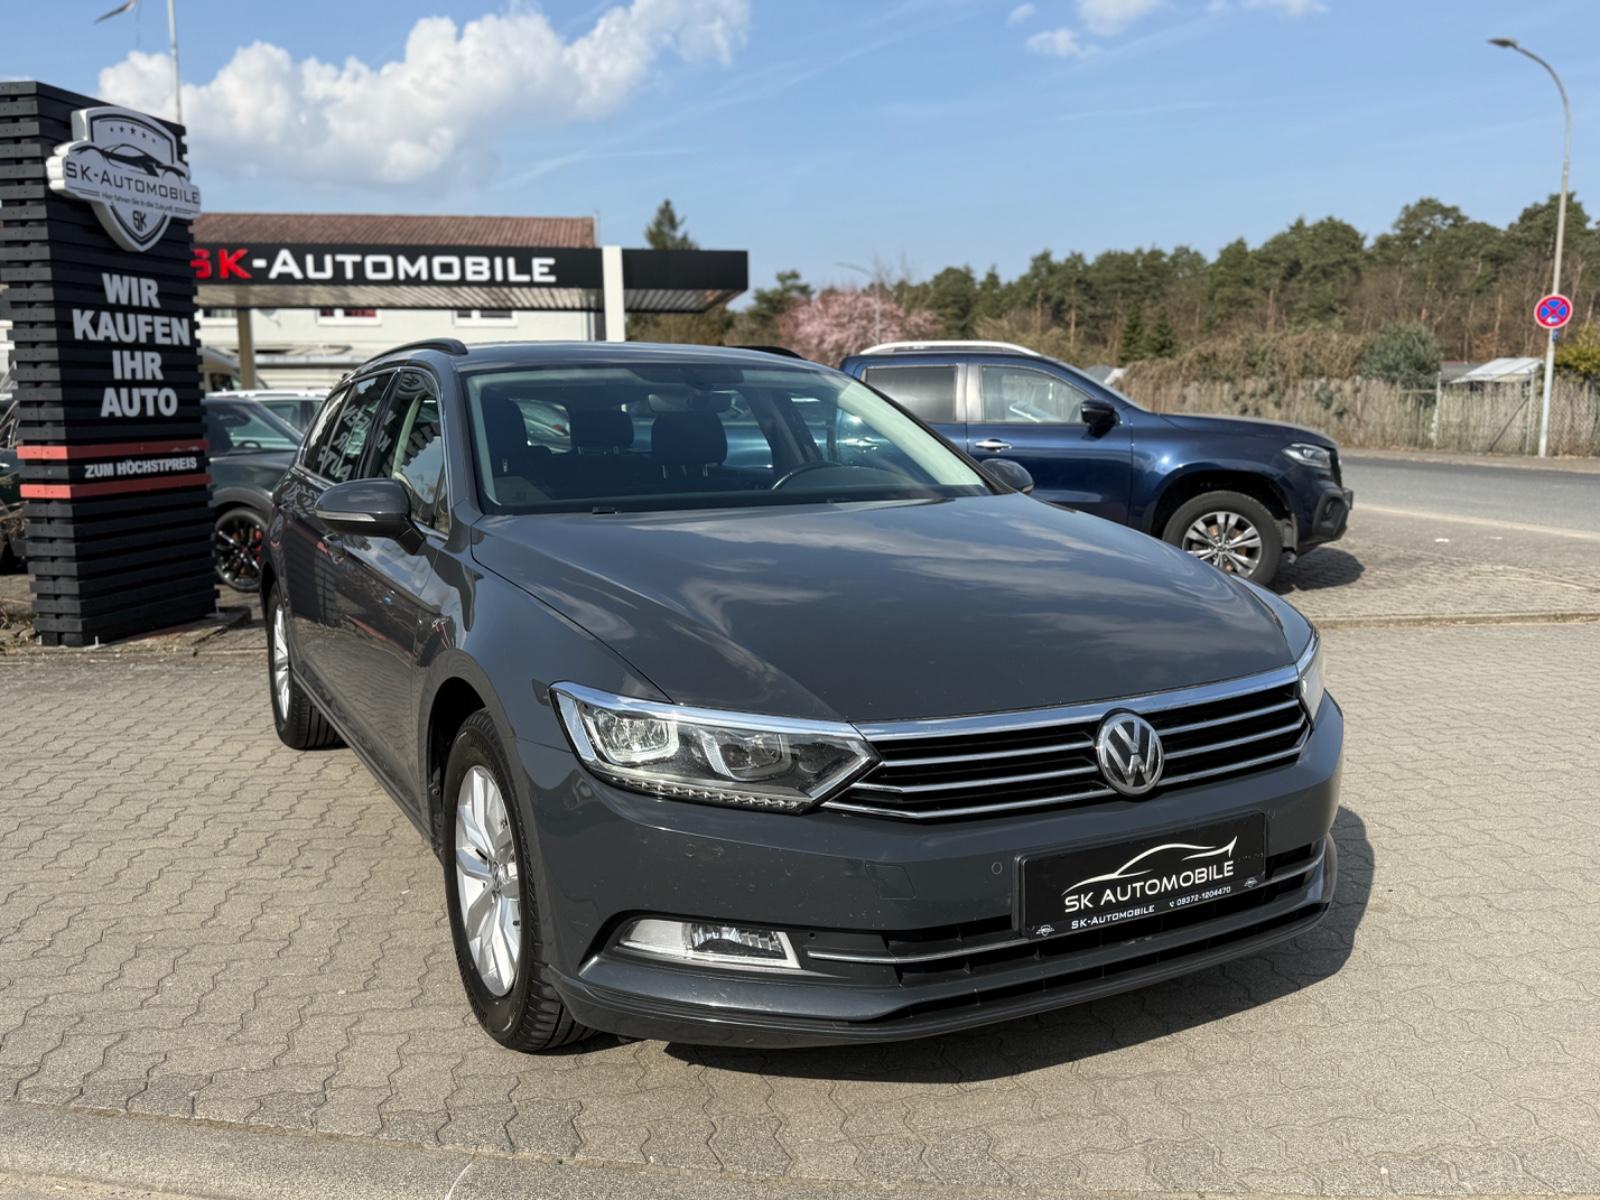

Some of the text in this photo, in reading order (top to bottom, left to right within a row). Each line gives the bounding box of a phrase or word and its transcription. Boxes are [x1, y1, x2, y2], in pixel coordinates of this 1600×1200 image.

[65, 161, 200, 204] SK-AUTOMOBILE
[132, 210, 147, 231] SK
[102, 273, 160, 308] WIR
[72, 309, 190, 346] KAUFEN
[112, 350, 164, 380] IHR
[100, 387, 178, 417] AUTO
[84, 456, 197, 478] ZUM HÖCHSTPREIS
[1101, 716, 1160, 791] VW
[1064, 860, 1235, 914] SK AUTOMOBILE
[1071, 904, 1155, 930] SK-AUTOMOBILE
